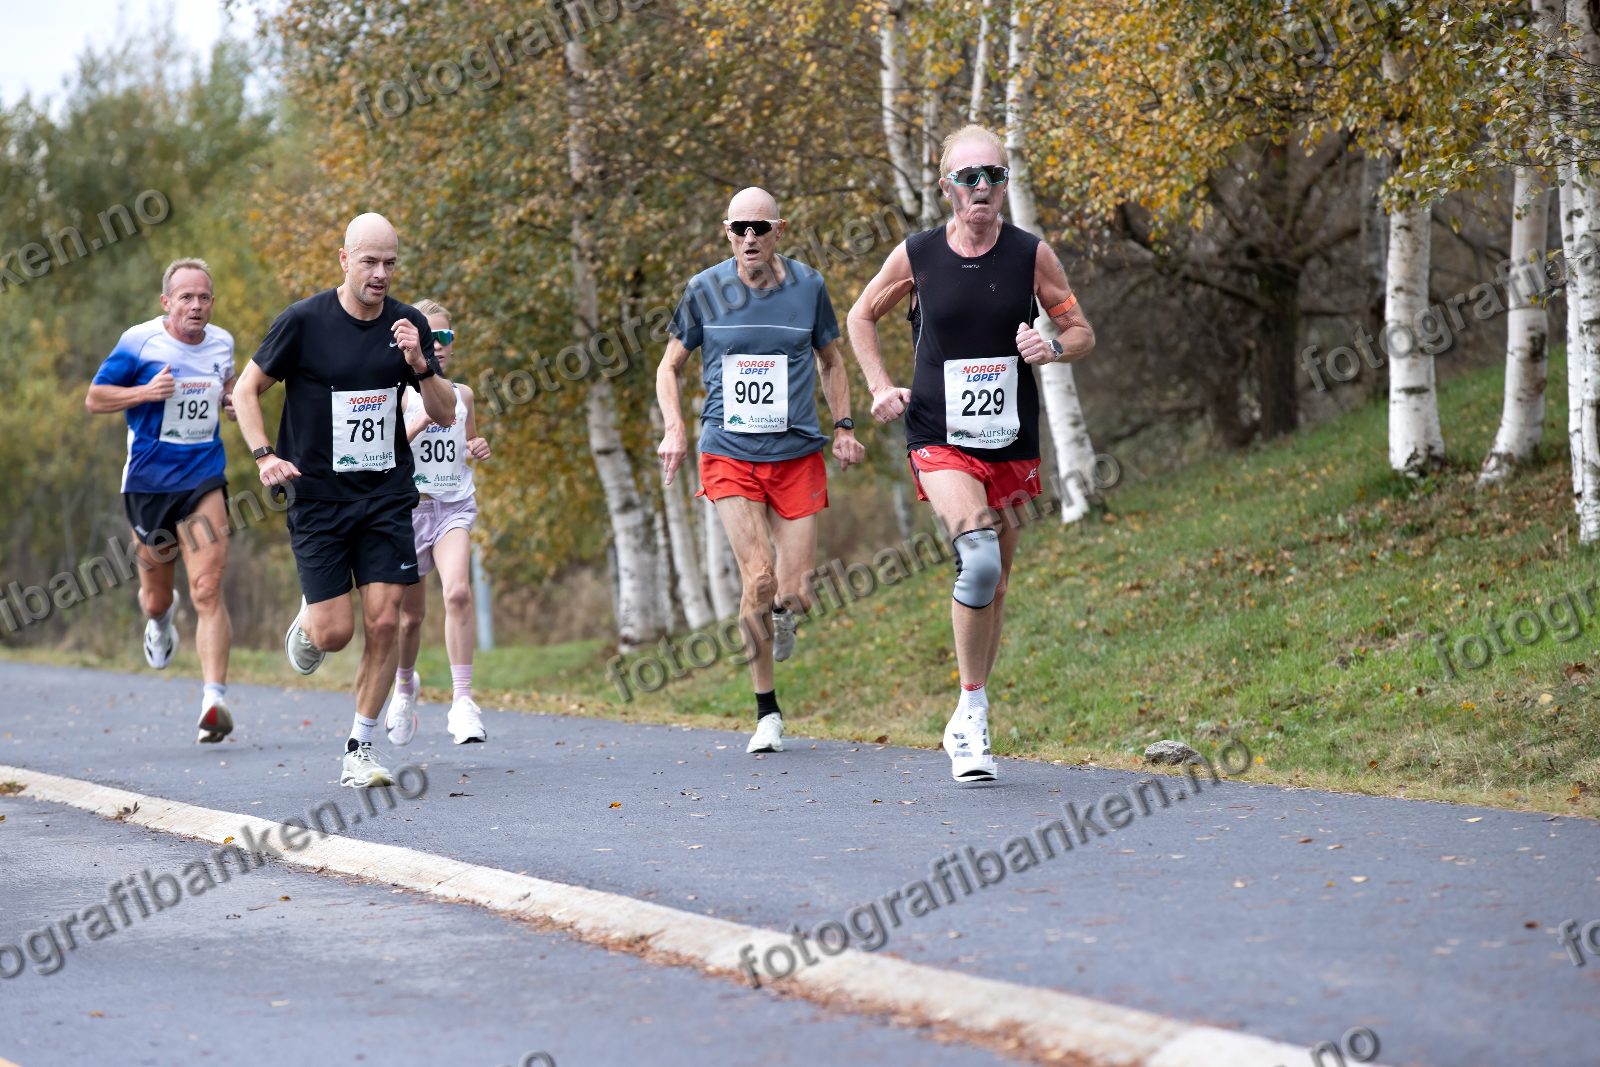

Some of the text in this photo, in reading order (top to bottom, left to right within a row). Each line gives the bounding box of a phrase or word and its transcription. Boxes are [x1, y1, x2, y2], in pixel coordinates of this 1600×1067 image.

[962, 363, 1007, 374] NORGES
[966, 373, 1001, 382] LØPET
[734, 381, 774, 404] 902
[347, 394, 388, 404] NORGES
[962, 388, 1005, 416] 229
[177, 400, 209, 420] 192
[352, 403, 383, 412] LØPET
[748, 415, 785, 424] Aurskog
[347, 417, 385, 443] 781
[979, 427, 1017, 438] Aurskog
[420, 439, 456, 463] 303
